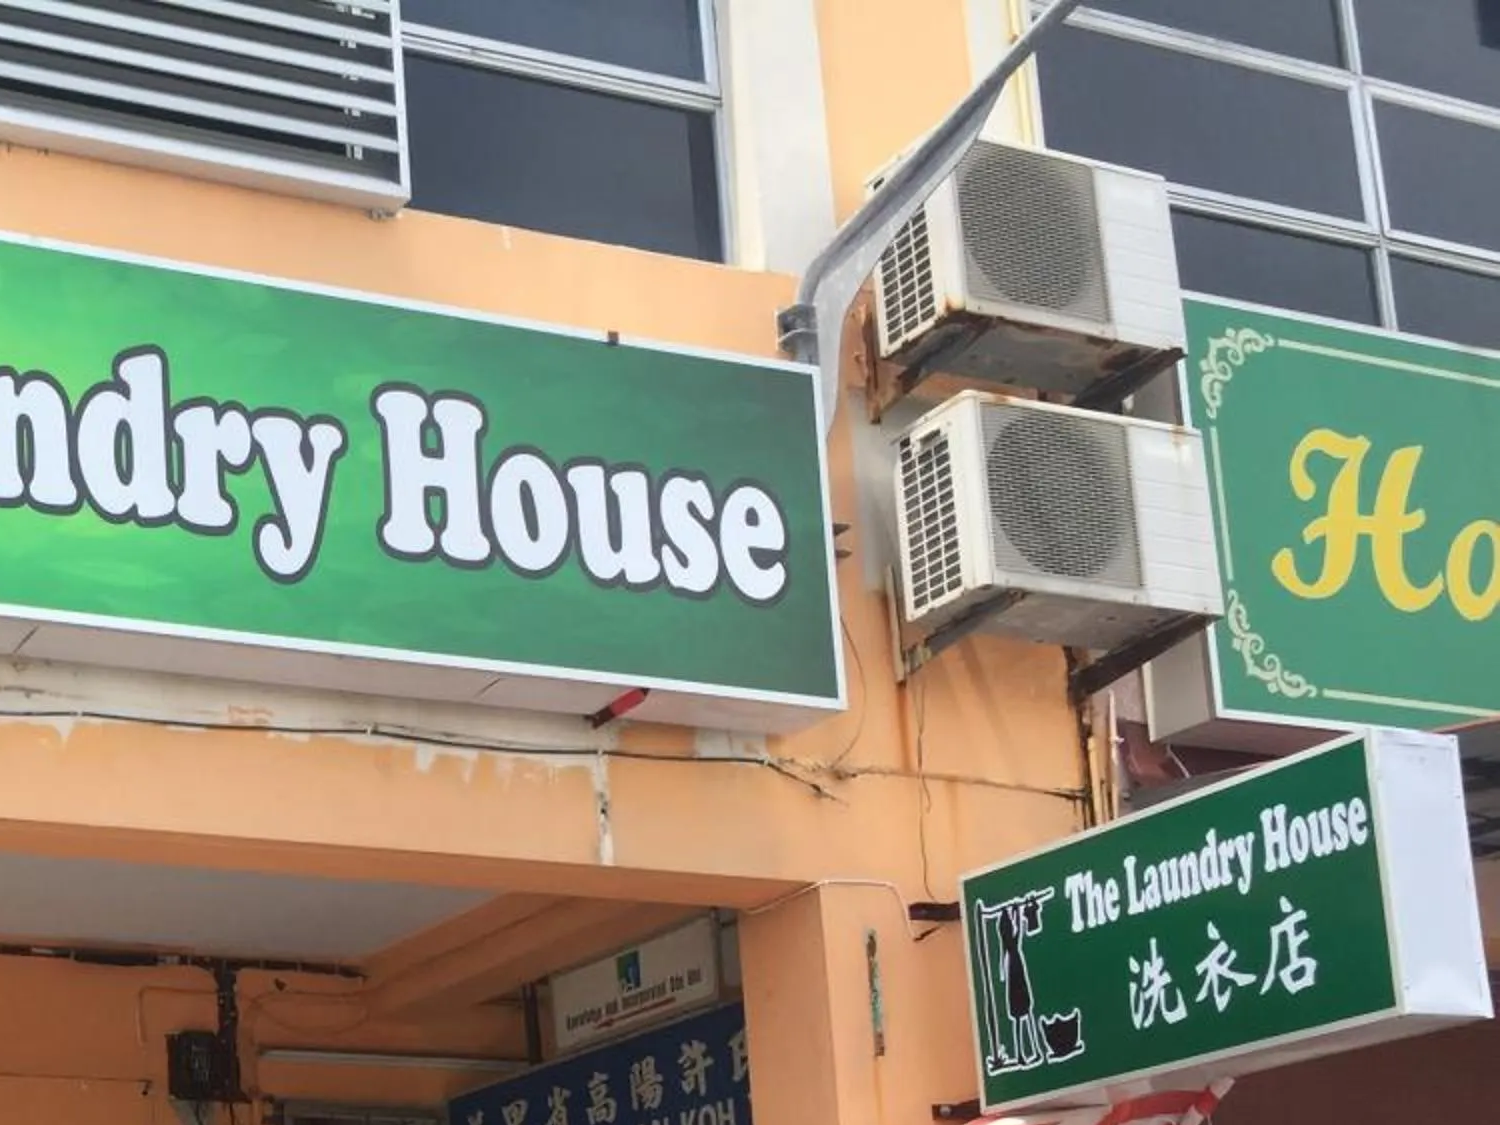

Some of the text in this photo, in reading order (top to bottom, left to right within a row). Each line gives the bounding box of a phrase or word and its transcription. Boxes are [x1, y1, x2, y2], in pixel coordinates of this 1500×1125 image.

[371, 381, 789, 607] House
[1064, 796, 1369, 934] The Laundry House
[1127, 895, 1318, 1031] 洗衣店
